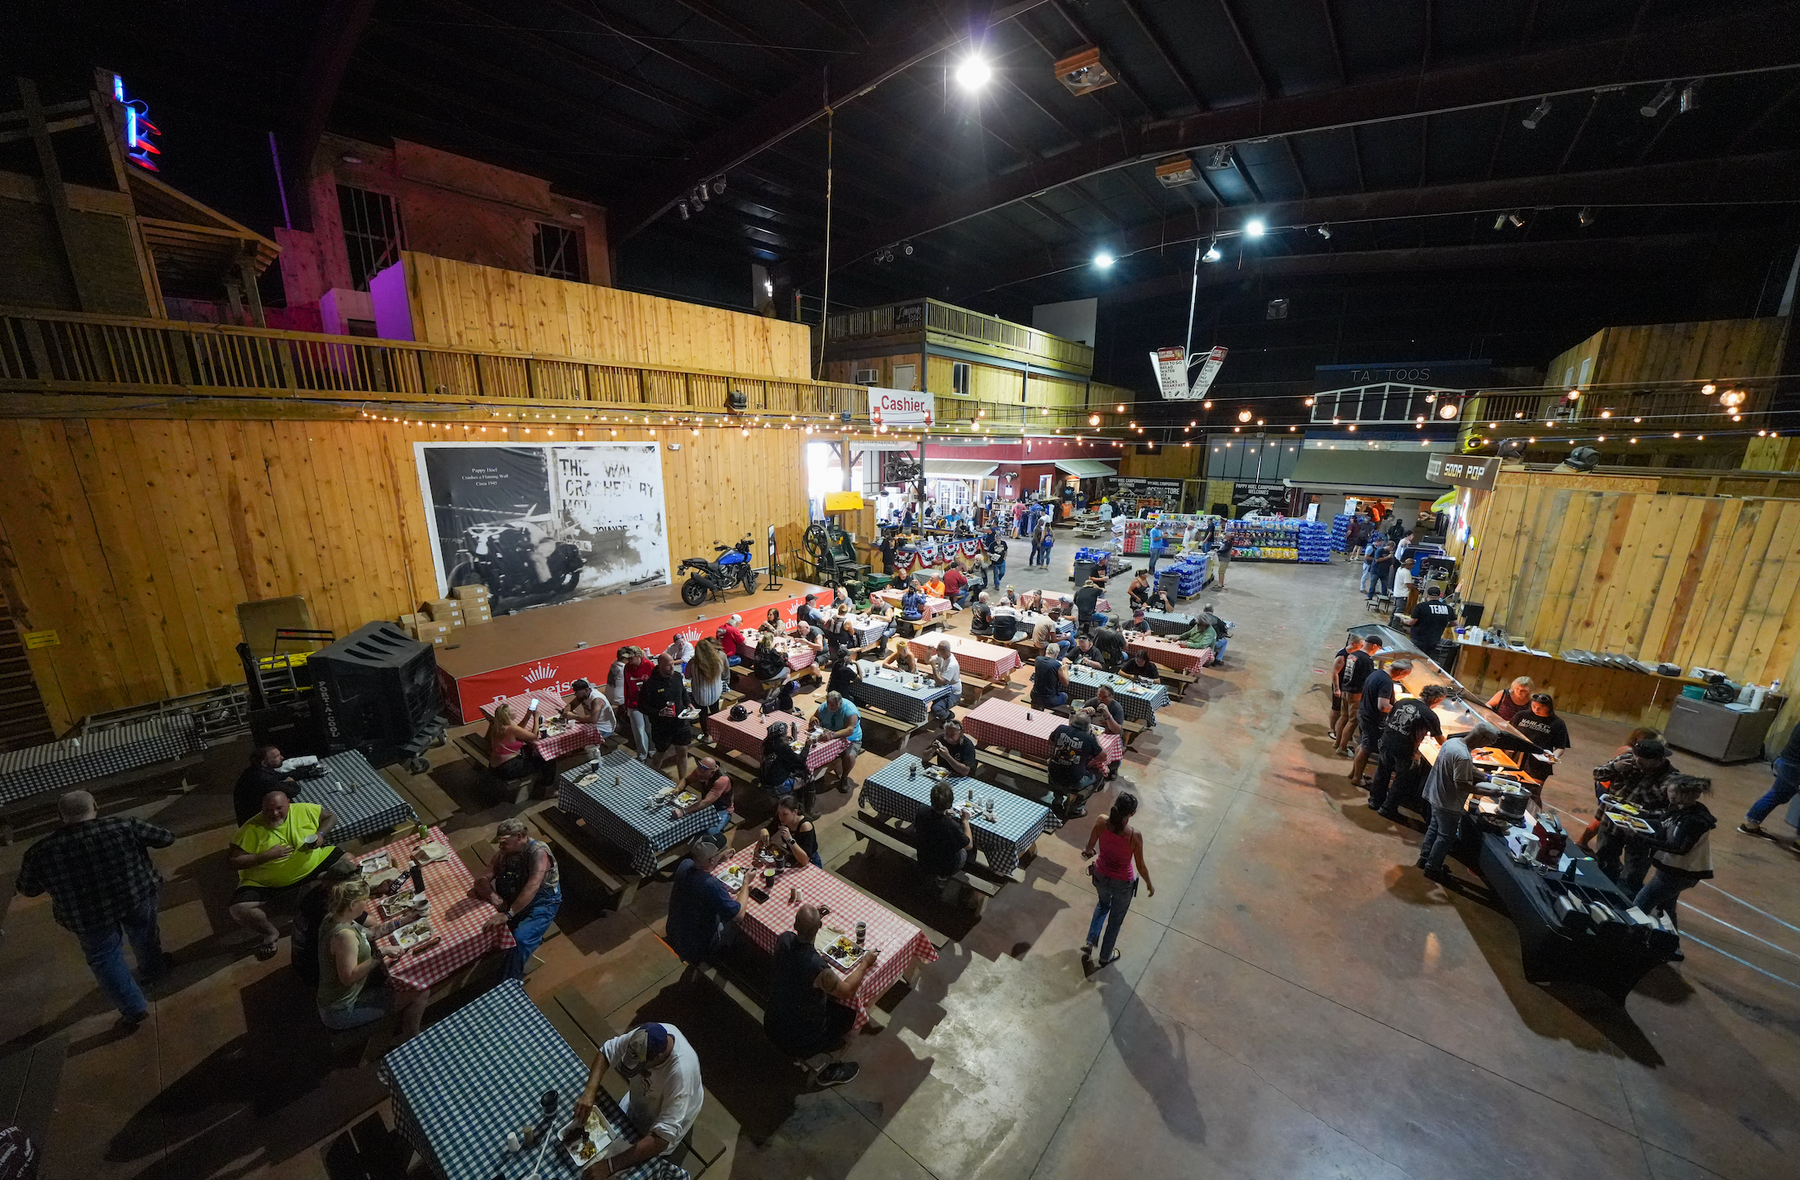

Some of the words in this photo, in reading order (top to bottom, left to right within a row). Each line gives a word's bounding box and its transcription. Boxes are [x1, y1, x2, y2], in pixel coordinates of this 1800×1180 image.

[881, 395, 925, 412] Cashier
[603, 460, 632, 478] WAL
[1443, 463, 1463, 478] SODA
[1465, 465, 1486, 481] POP
[1429, 604, 1449, 615] TEAM
